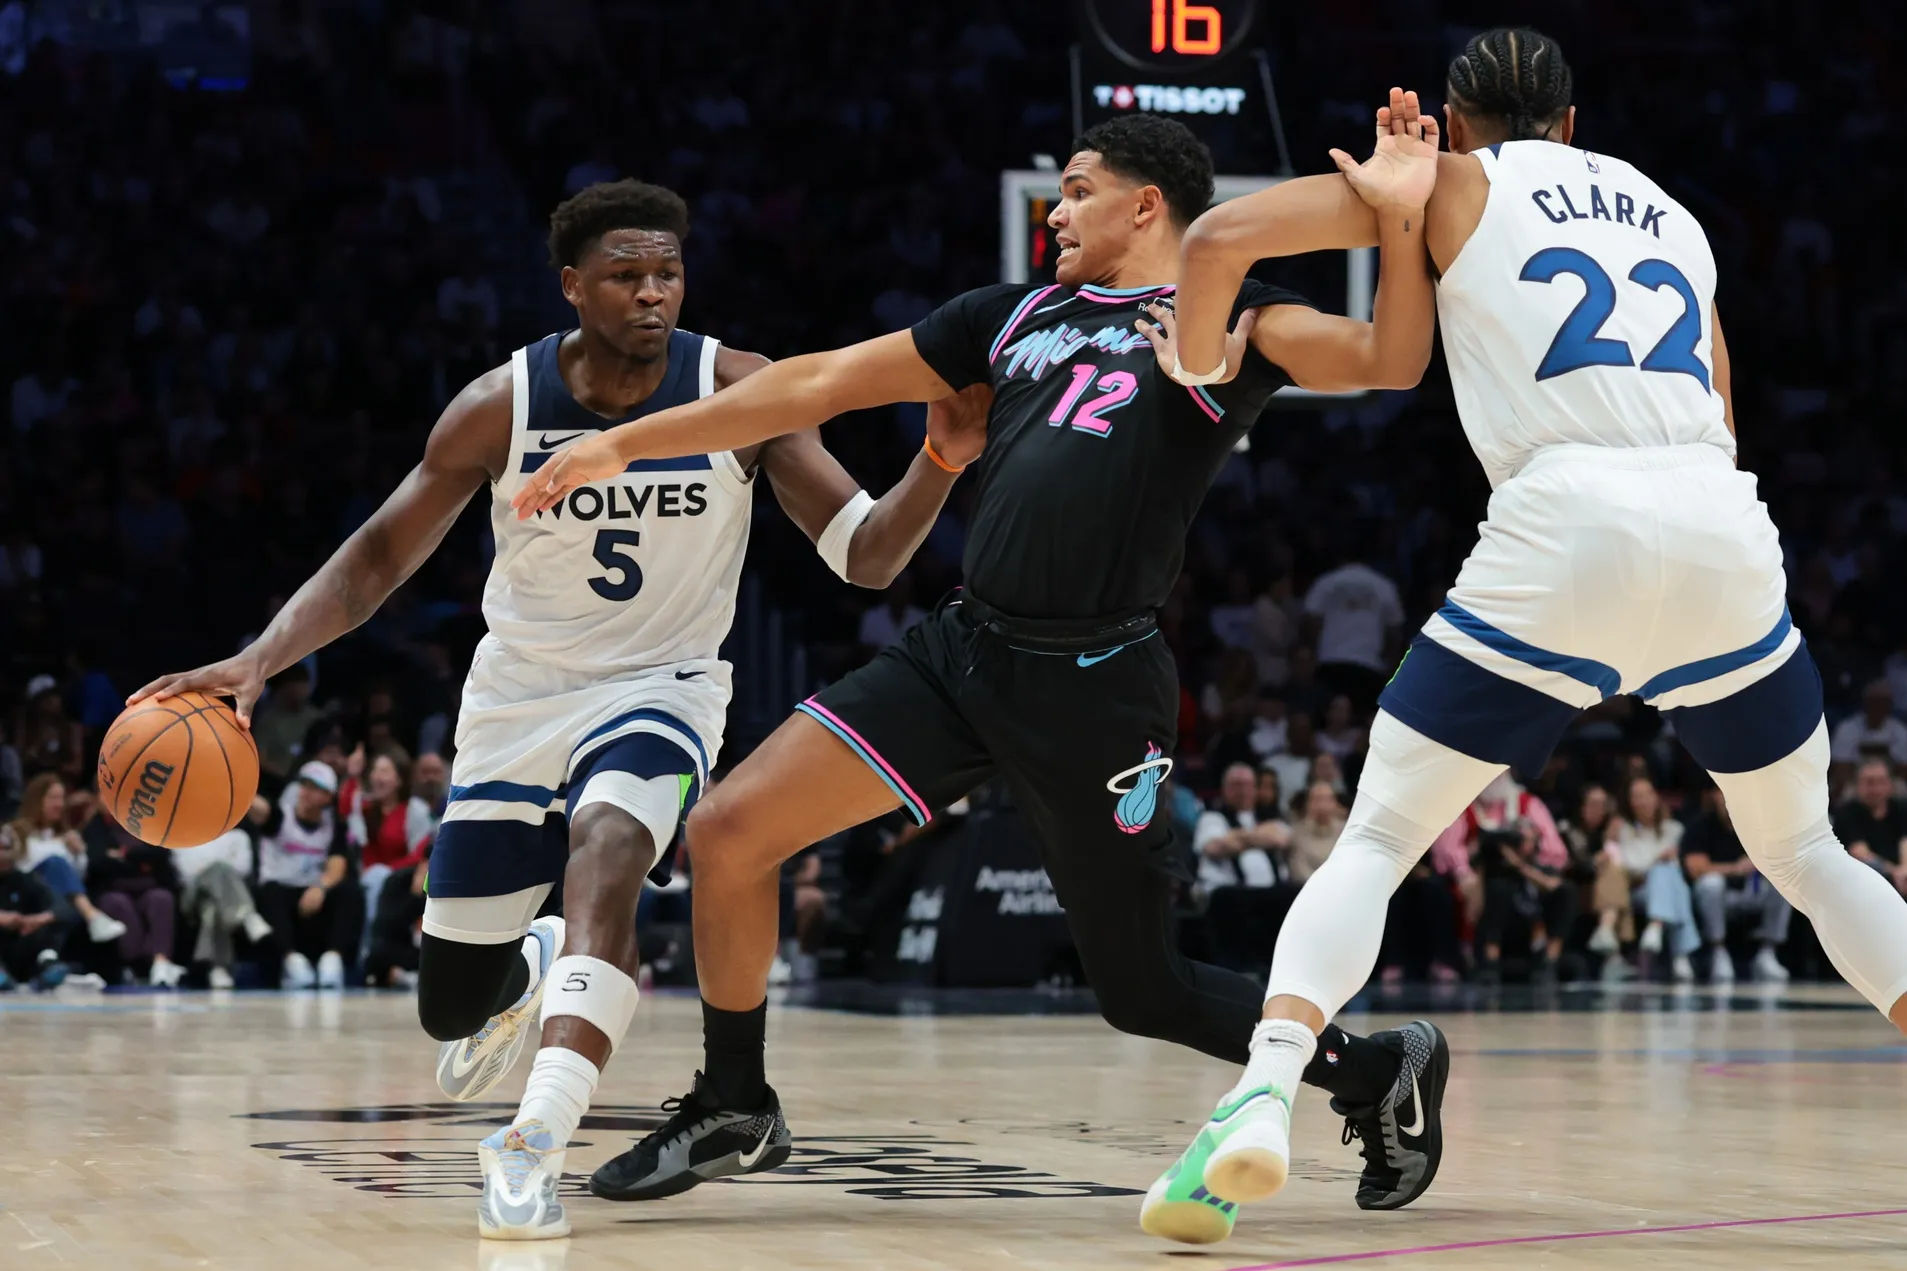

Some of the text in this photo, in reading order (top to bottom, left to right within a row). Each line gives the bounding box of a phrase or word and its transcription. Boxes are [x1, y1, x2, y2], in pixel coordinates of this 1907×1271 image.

[1151, 0, 1221, 55] 16
[1134, 84, 1246, 115] TISSOT
[1532, 184, 1667, 239] CLARK
[1519, 247, 1711, 397] 22
[1048, 364, 1138, 438] 12
[587, 529, 643, 602] 5
[975, 865, 1053, 892] Ameri
[997, 891, 1065, 915] Airlin
[562, 972, 591, 992] 5
